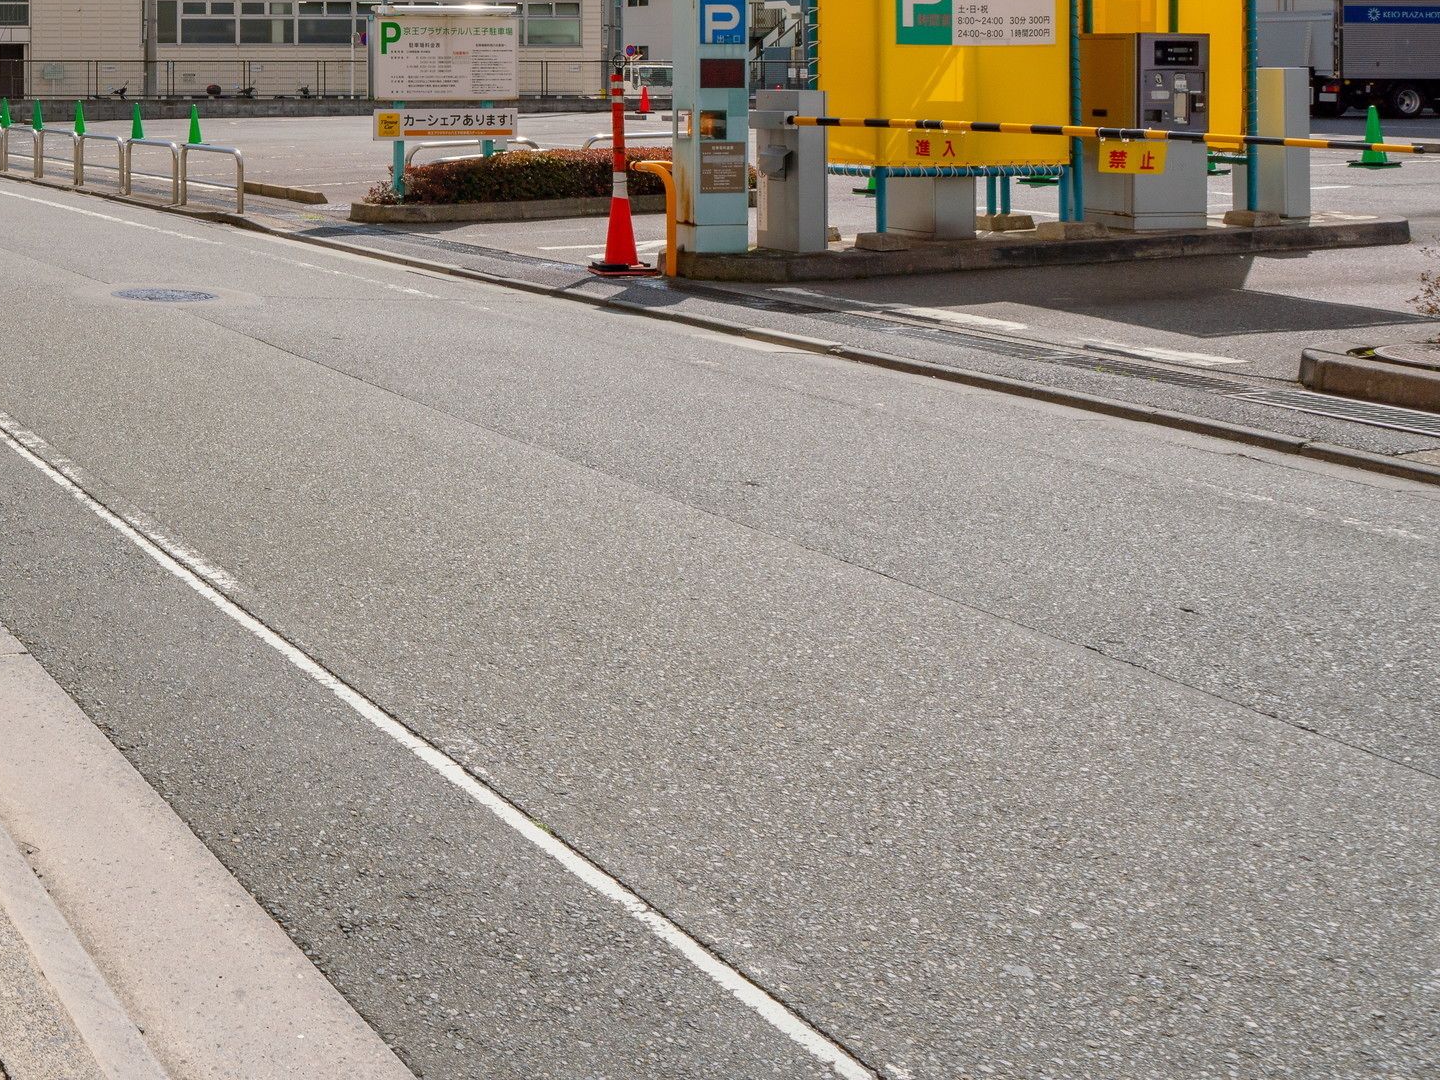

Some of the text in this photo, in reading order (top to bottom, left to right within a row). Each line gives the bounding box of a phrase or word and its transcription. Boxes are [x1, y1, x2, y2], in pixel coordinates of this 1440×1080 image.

[704, 4, 740, 44] P
[380, 22, 401, 54] P
[915, 140, 956, 157] 進入
[1108, 150, 1155, 170] 禁止
